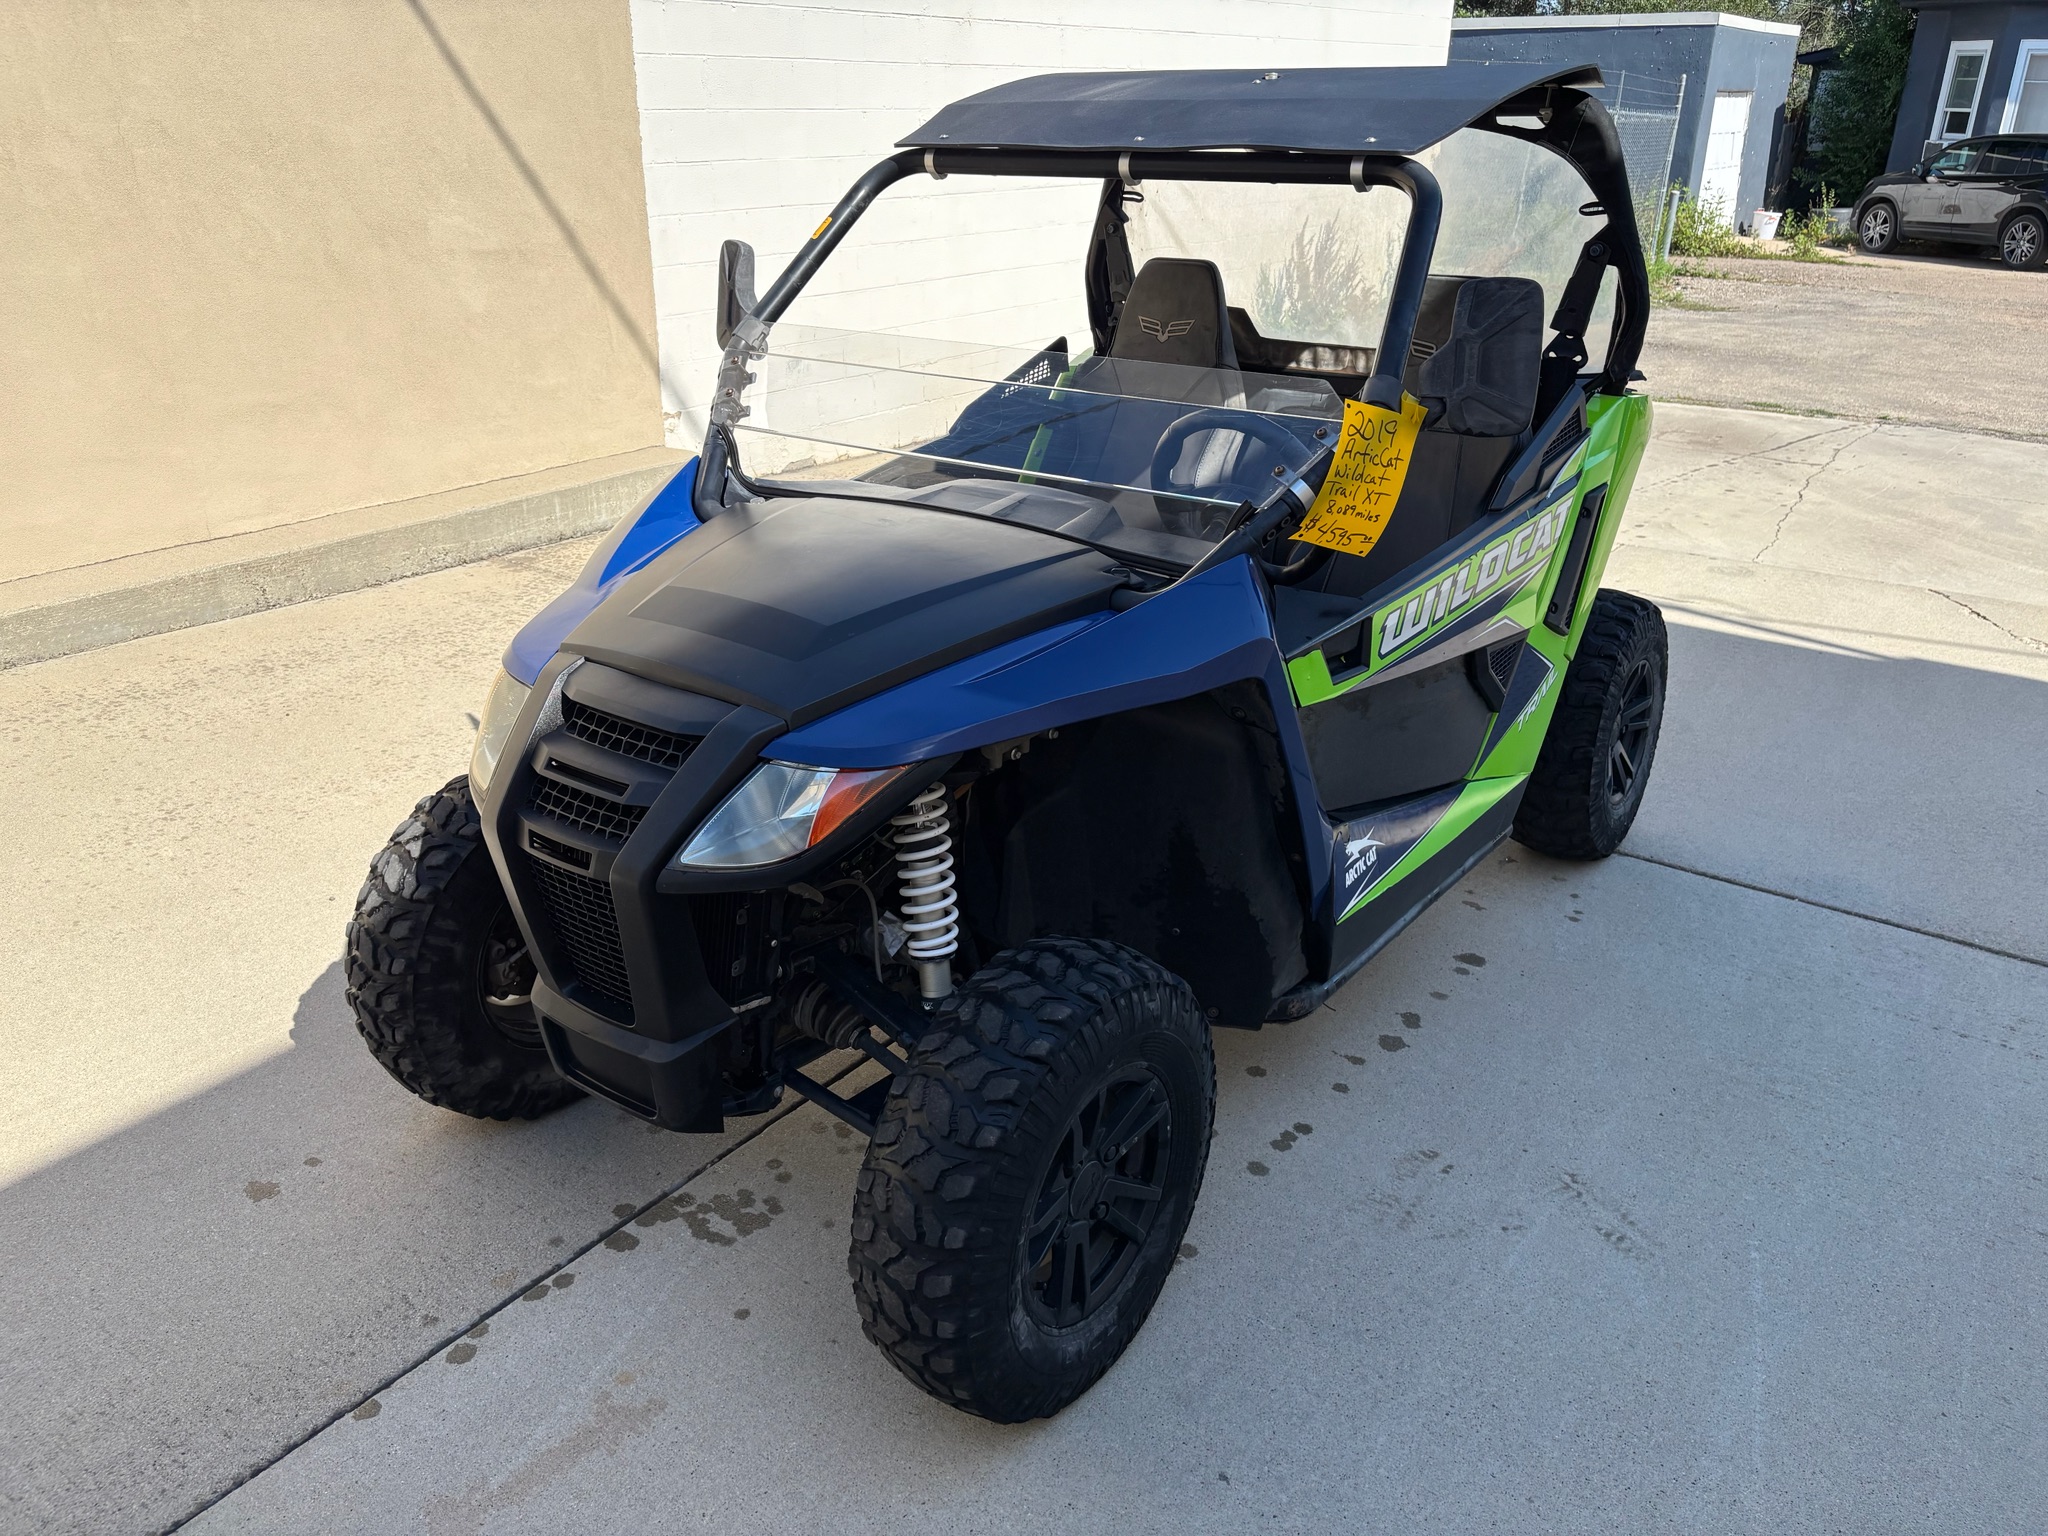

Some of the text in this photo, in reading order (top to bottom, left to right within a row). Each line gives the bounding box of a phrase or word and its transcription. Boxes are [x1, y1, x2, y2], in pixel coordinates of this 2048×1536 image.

[1347, 411, 1398, 448] 2019
[1326, 481, 1391, 506] Trail XT
[1335, 463, 1391, 487] Wildcat
[1378, 496, 1574, 660] WILDCAT
[1516, 669, 1559, 733] TRAIL
[1345, 845, 1378, 889] ARCTIC CAT
